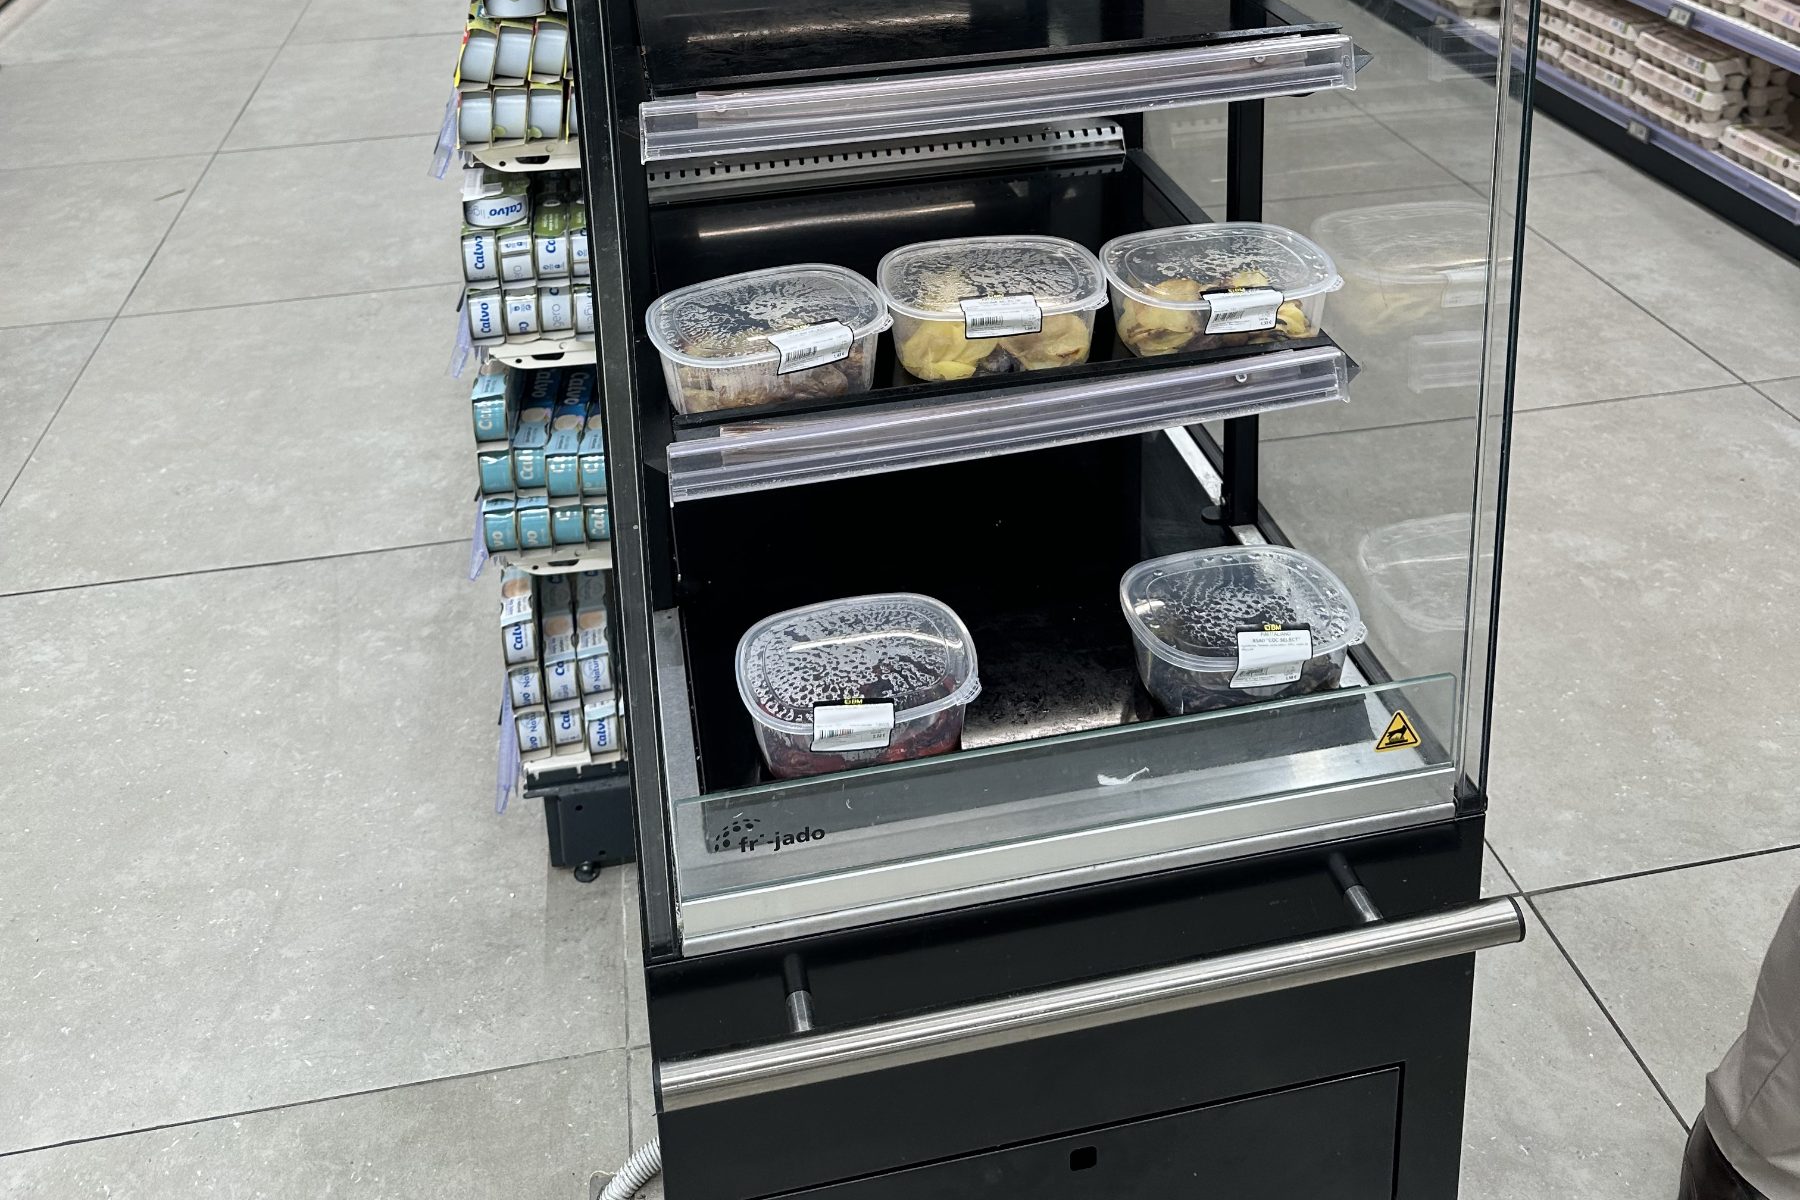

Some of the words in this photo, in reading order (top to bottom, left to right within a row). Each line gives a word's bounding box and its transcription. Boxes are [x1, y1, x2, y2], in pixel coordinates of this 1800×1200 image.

[489, 202, 523, 217] Calvo
[474, 235, 486, 270] Calvo
[479, 303, 492, 334] Calvo
